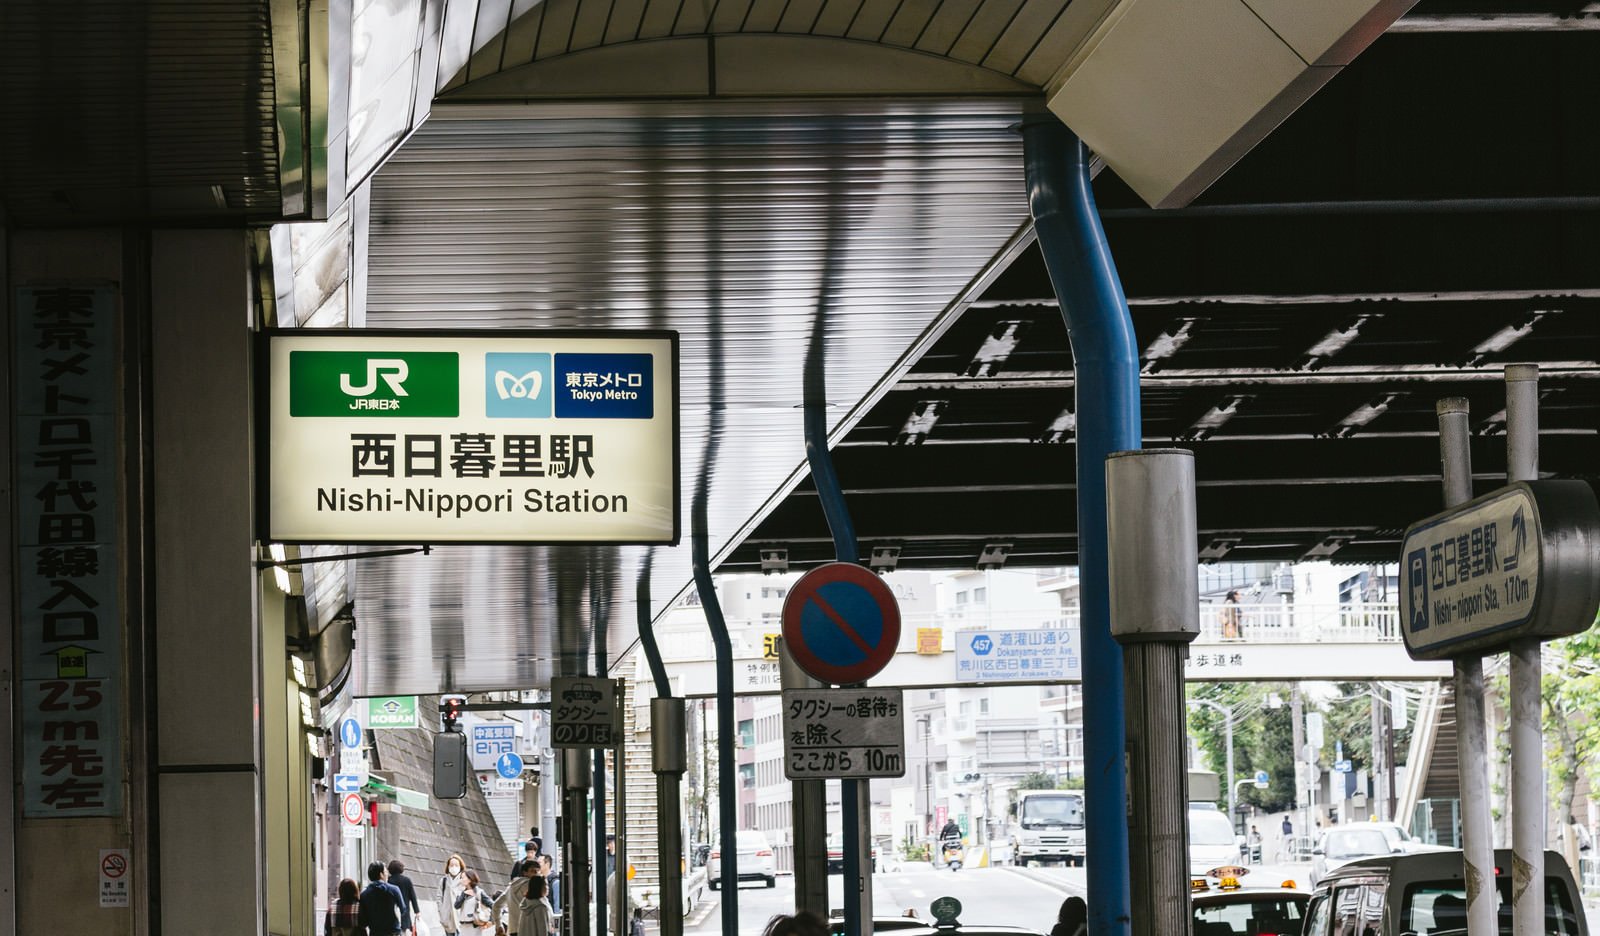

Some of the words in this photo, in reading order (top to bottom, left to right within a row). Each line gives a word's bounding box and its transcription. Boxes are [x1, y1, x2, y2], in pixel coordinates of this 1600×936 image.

[340, 358, 409, 396] JR
[565, 372, 642, 388] 東京メトロ
[349, 398, 400, 411] JR東日本
[570, 388, 603, 402] Tokyo
[605, 388, 638, 400] Metro
[33, 287, 100, 643] 東京メトロ千代田線入口
[350, 432, 595, 479] 西日暮里駅
[317, 487, 513, 518] Nishi-Nippori
[523, 487, 628, 513] Station
[1430, 522, 1499, 591] 西日暮里駅
[1484, 583, 1500, 611] Sta.
[1504, 575, 1529, 606] 170m
[973, 639, 990, 651] 457
[999, 631, 1071, 646] 道灌山通り
[959, 656, 1079, 672] 荒川区西日暮里三丁目
[370, 712, 414, 724] KOBAN
[556, 705, 609, 721] タクシー
[789, 696, 898, 720] タクシーの客待ち
[555, 724, 609, 743] のりば
[791, 723, 843, 745] を除く
[791, 751, 852, 771] ここから
[864, 749, 900, 771] 10m
